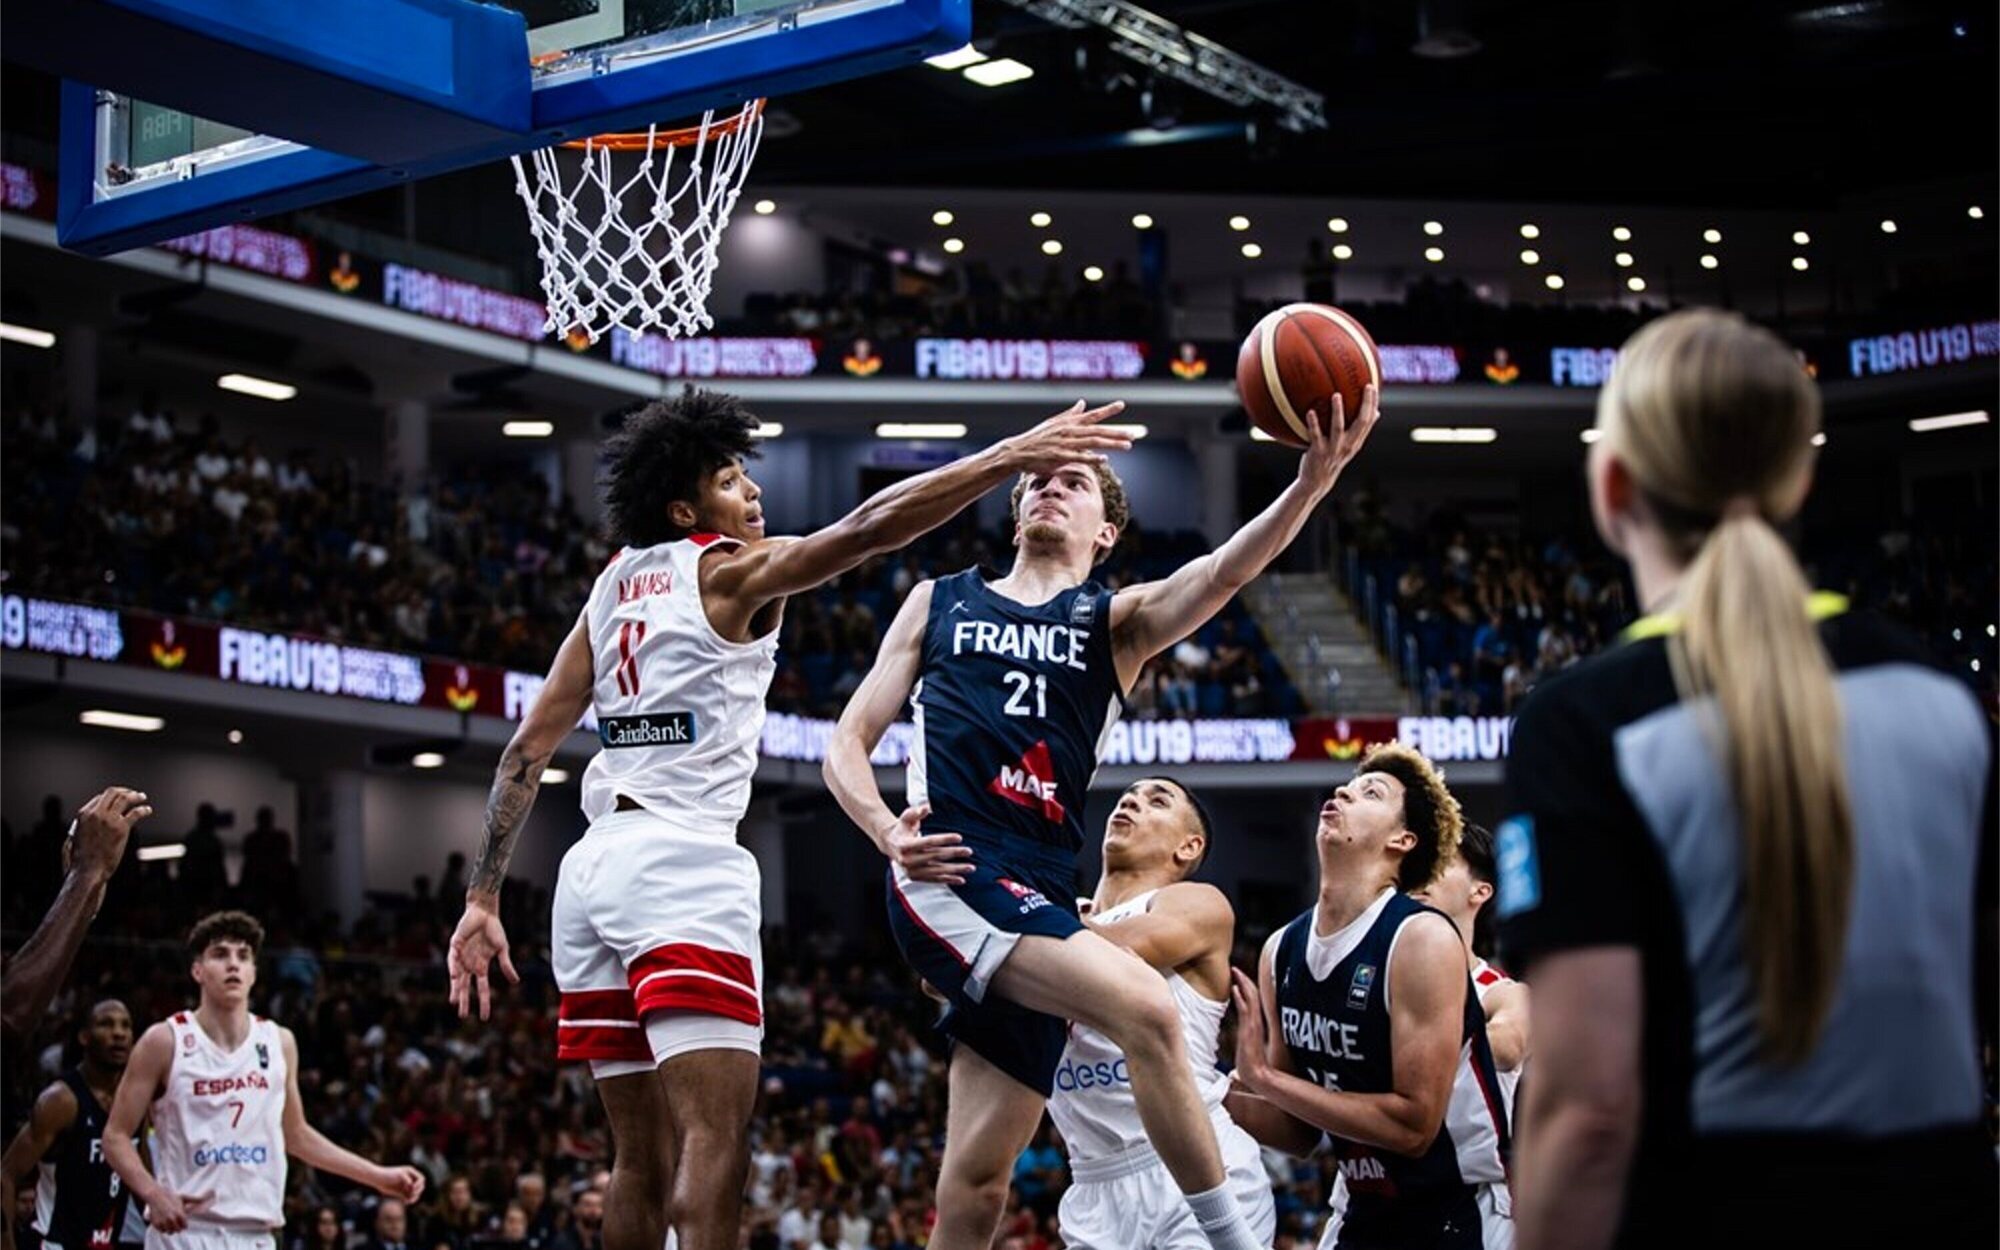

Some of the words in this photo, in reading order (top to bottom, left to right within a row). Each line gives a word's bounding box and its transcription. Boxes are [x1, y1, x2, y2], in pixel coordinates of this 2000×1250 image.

[915, 338, 992, 379] FIBA
[993, 339, 1049, 379] U19
[1851, 331, 1918, 377] FIBA
[1919, 323, 1971, 366] U19
[219, 627, 288, 687] FIBA
[289, 637, 341, 694] U19
[616, 620, 646, 697] 11
[953, 620, 1090, 672] FRANCE
[1003, 670, 1047, 719] 21
[1397, 715, 1475, 761] FIBA
[1477, 715, 1510, 760] U1
[1281, 1006, 1364, 1061] FRANCE
[193, 1070, 269, 1096] ESPAÑA
[228, 1101, 244, 1129] 7
[109, 1171, 121, 1199] 8
